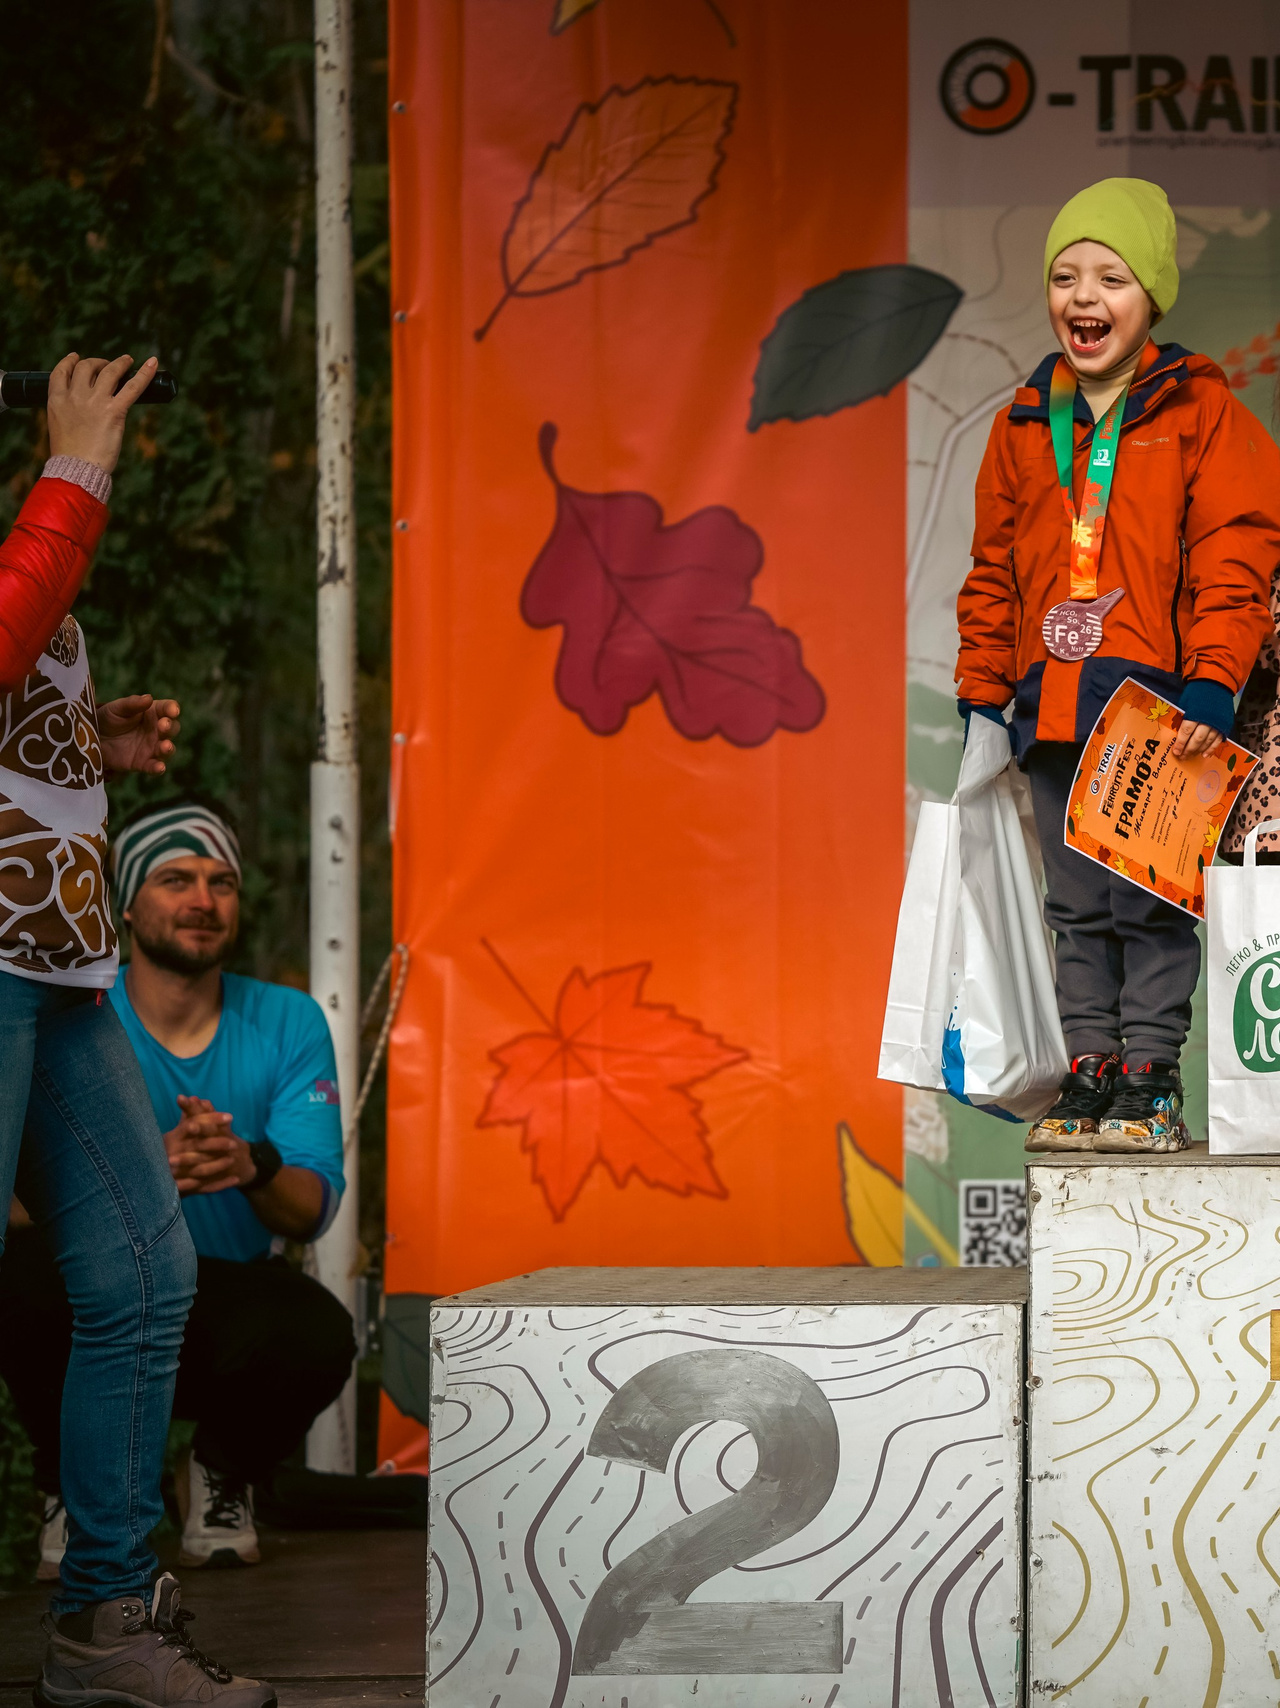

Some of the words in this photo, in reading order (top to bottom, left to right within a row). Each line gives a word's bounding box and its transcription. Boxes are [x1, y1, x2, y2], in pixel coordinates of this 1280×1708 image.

[1055, 624, 1079, 645] Fe
[1080, 624, 1092, 635] 26
[1115, 738, 1160, 839] ГРАМОТА
[1226, 947, 1251, 976] ЛЕГКО
[1252, 938, 1263, 951] &
[571, 1349, 844, 1675] 2
